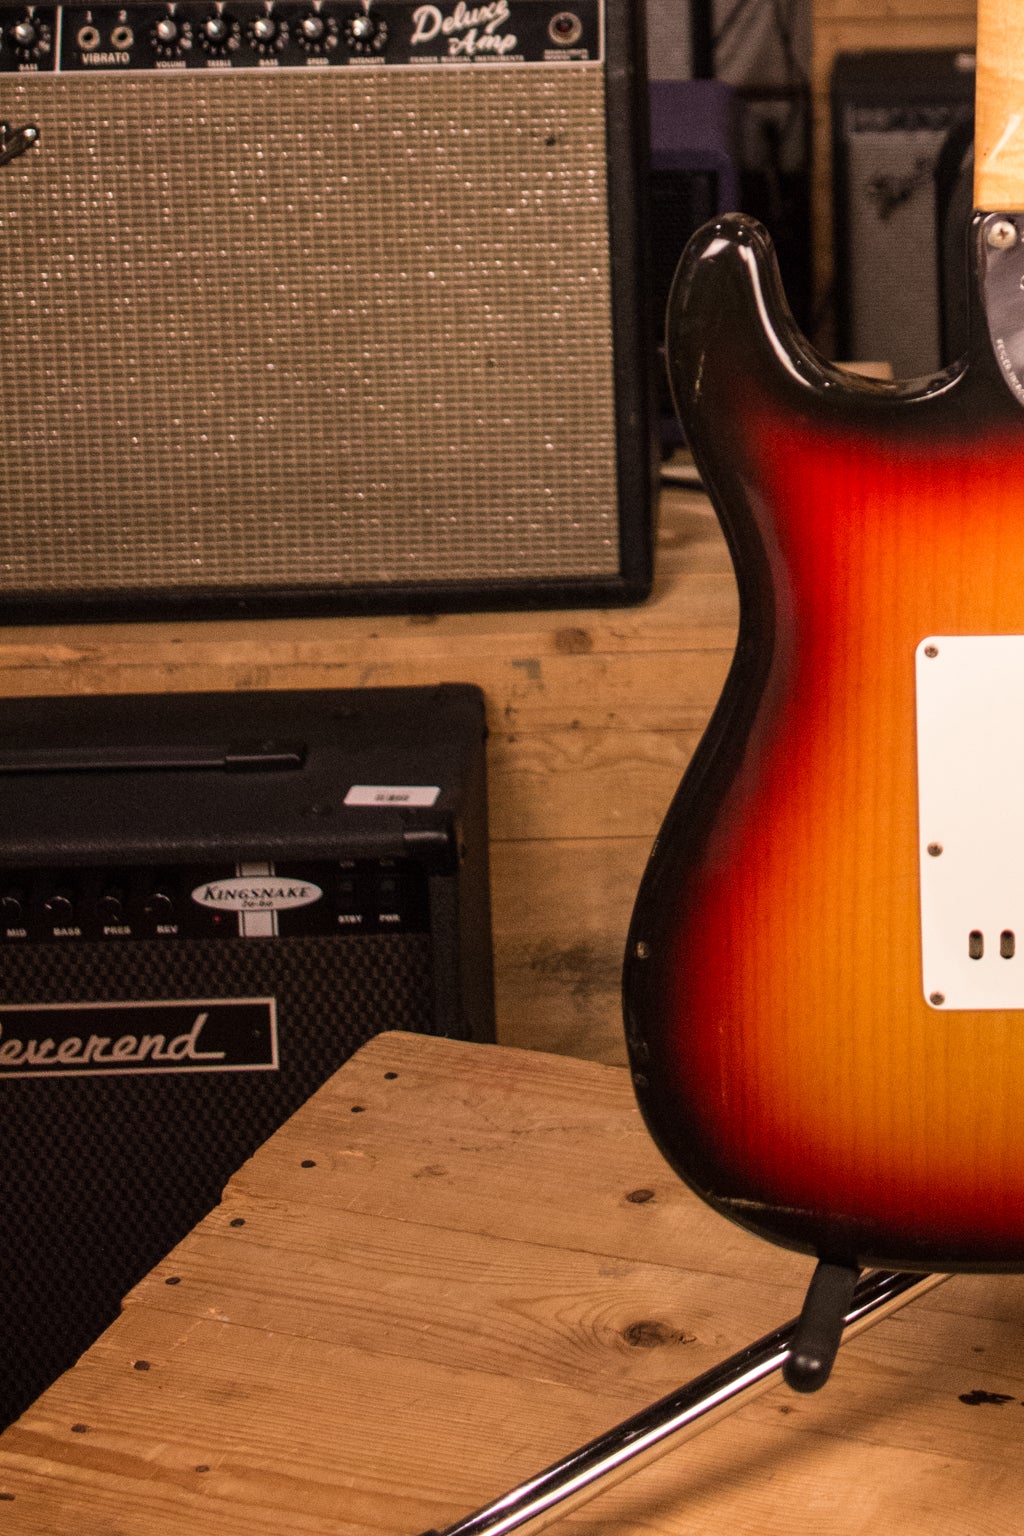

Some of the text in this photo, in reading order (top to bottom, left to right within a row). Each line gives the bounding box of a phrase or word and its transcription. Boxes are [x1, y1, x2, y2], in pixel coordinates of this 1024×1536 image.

[410, 0, 511, 46] Deluxe
[448, 28, 518, 56] Amp
[81, 52, 131, 65] VIBRATO
[203, 885, 312, 901] KINGSNAKE
[53, 927, 82, 937] BASS
[103, 925, 132, 936] PRES
[156, 924, 179, 935] REV
[0, 1012, 227, 1065] everend
